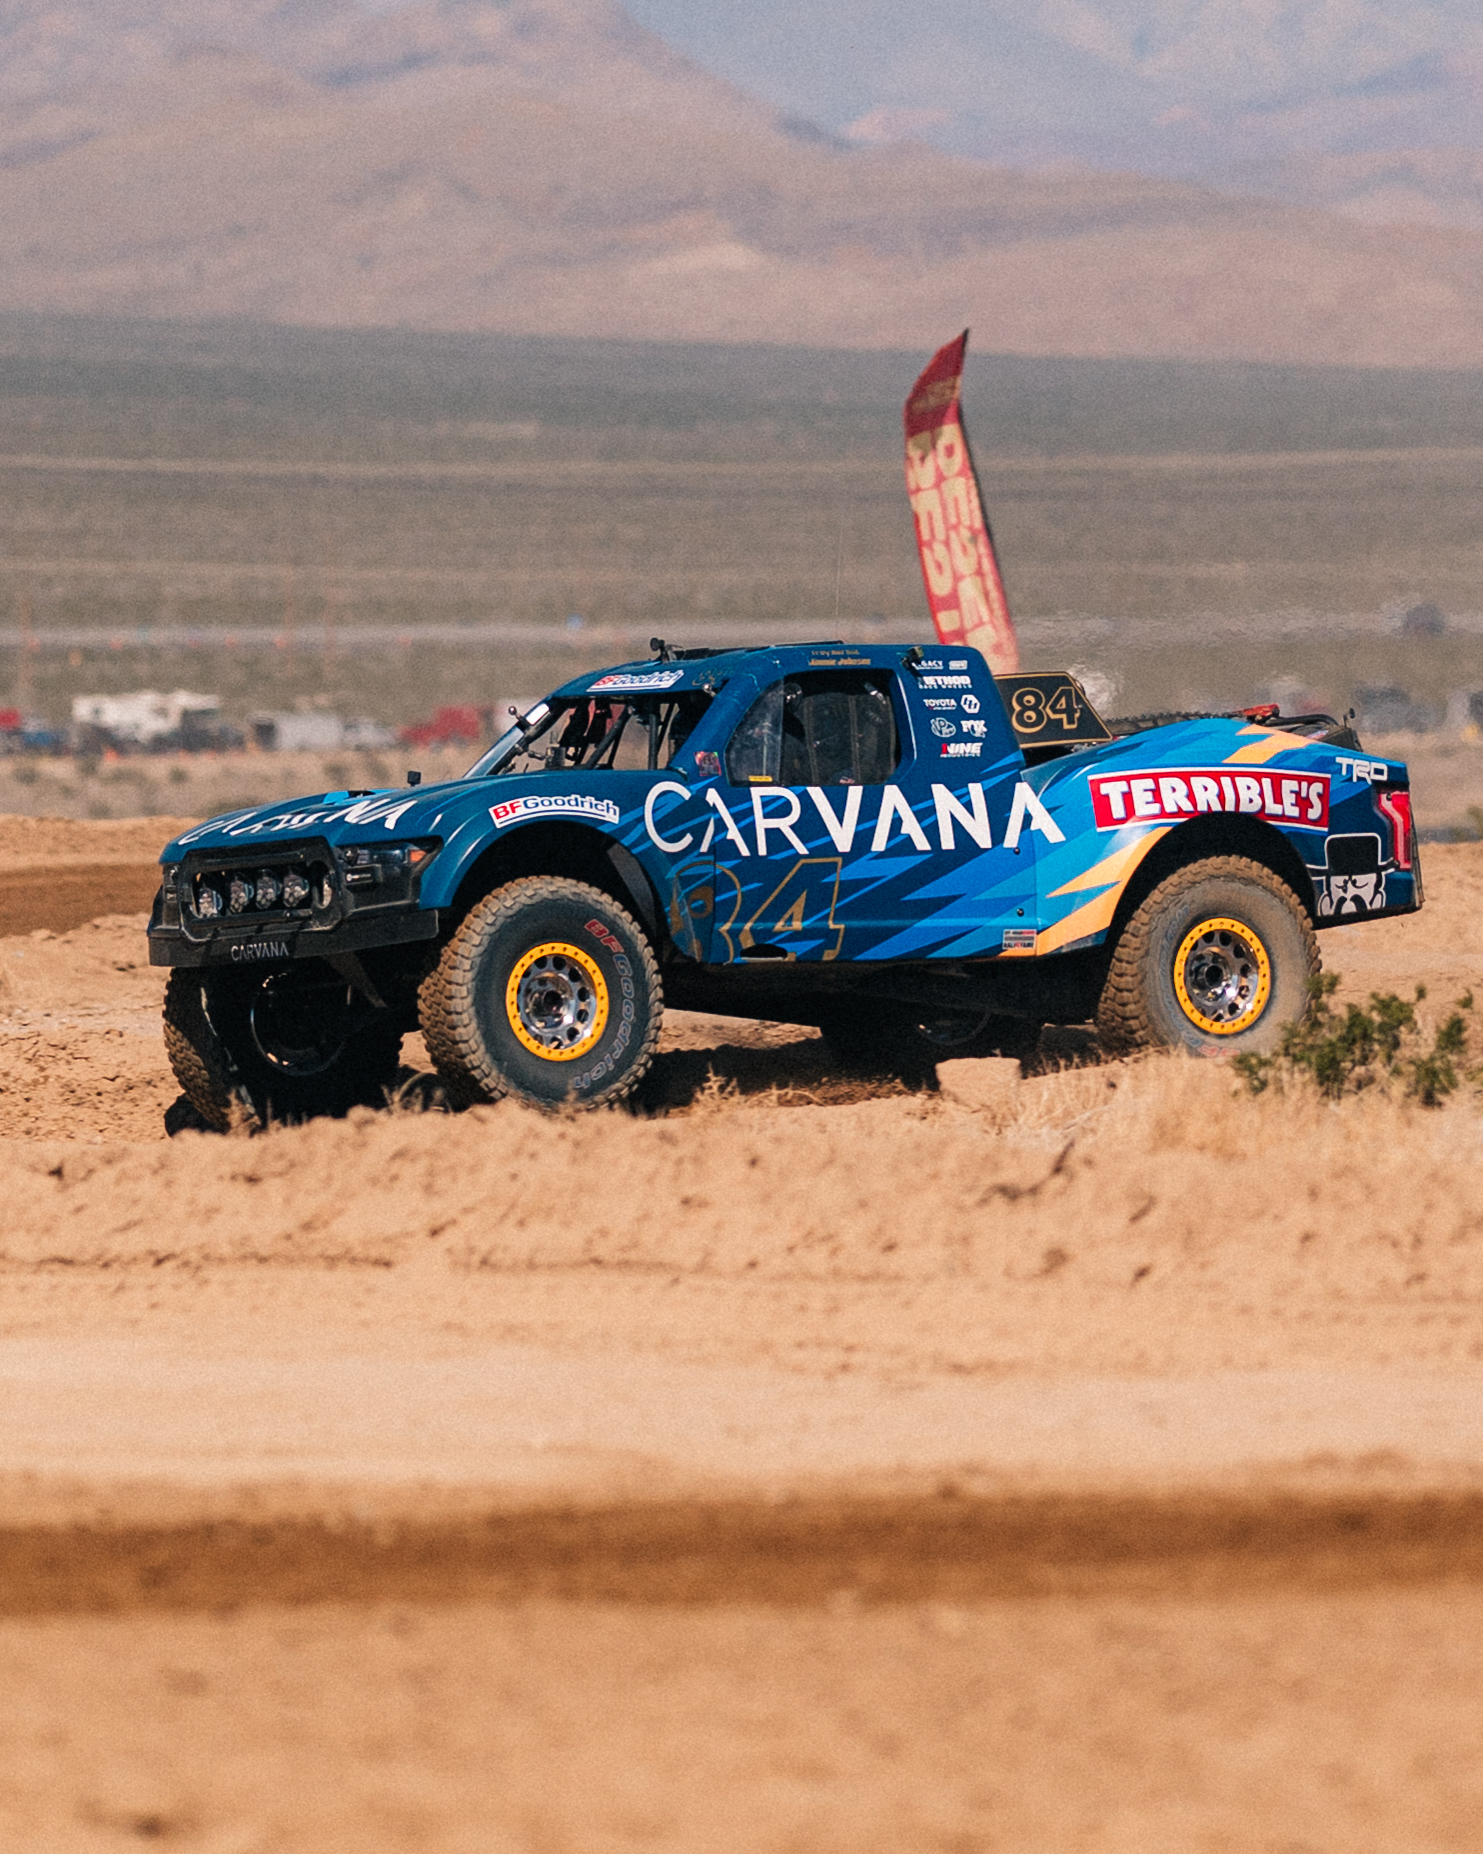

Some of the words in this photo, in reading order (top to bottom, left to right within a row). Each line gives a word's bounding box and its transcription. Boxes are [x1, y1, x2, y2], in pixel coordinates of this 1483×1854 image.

[923, 699, 957, 707] TOYOTA
[1012, 687, 1080, 733] 84
[1336, 757, 1388, 784] TRD
[493, 797, 617, 819] BFGoodrich
[1100, 776, 1323, 821] TERRIBLE'S
[644, 781, 1066, 857] CARVANA
[231, 941, 289, 961] CARVANA
[574, 919, 635, 1089] BFGoodrich
